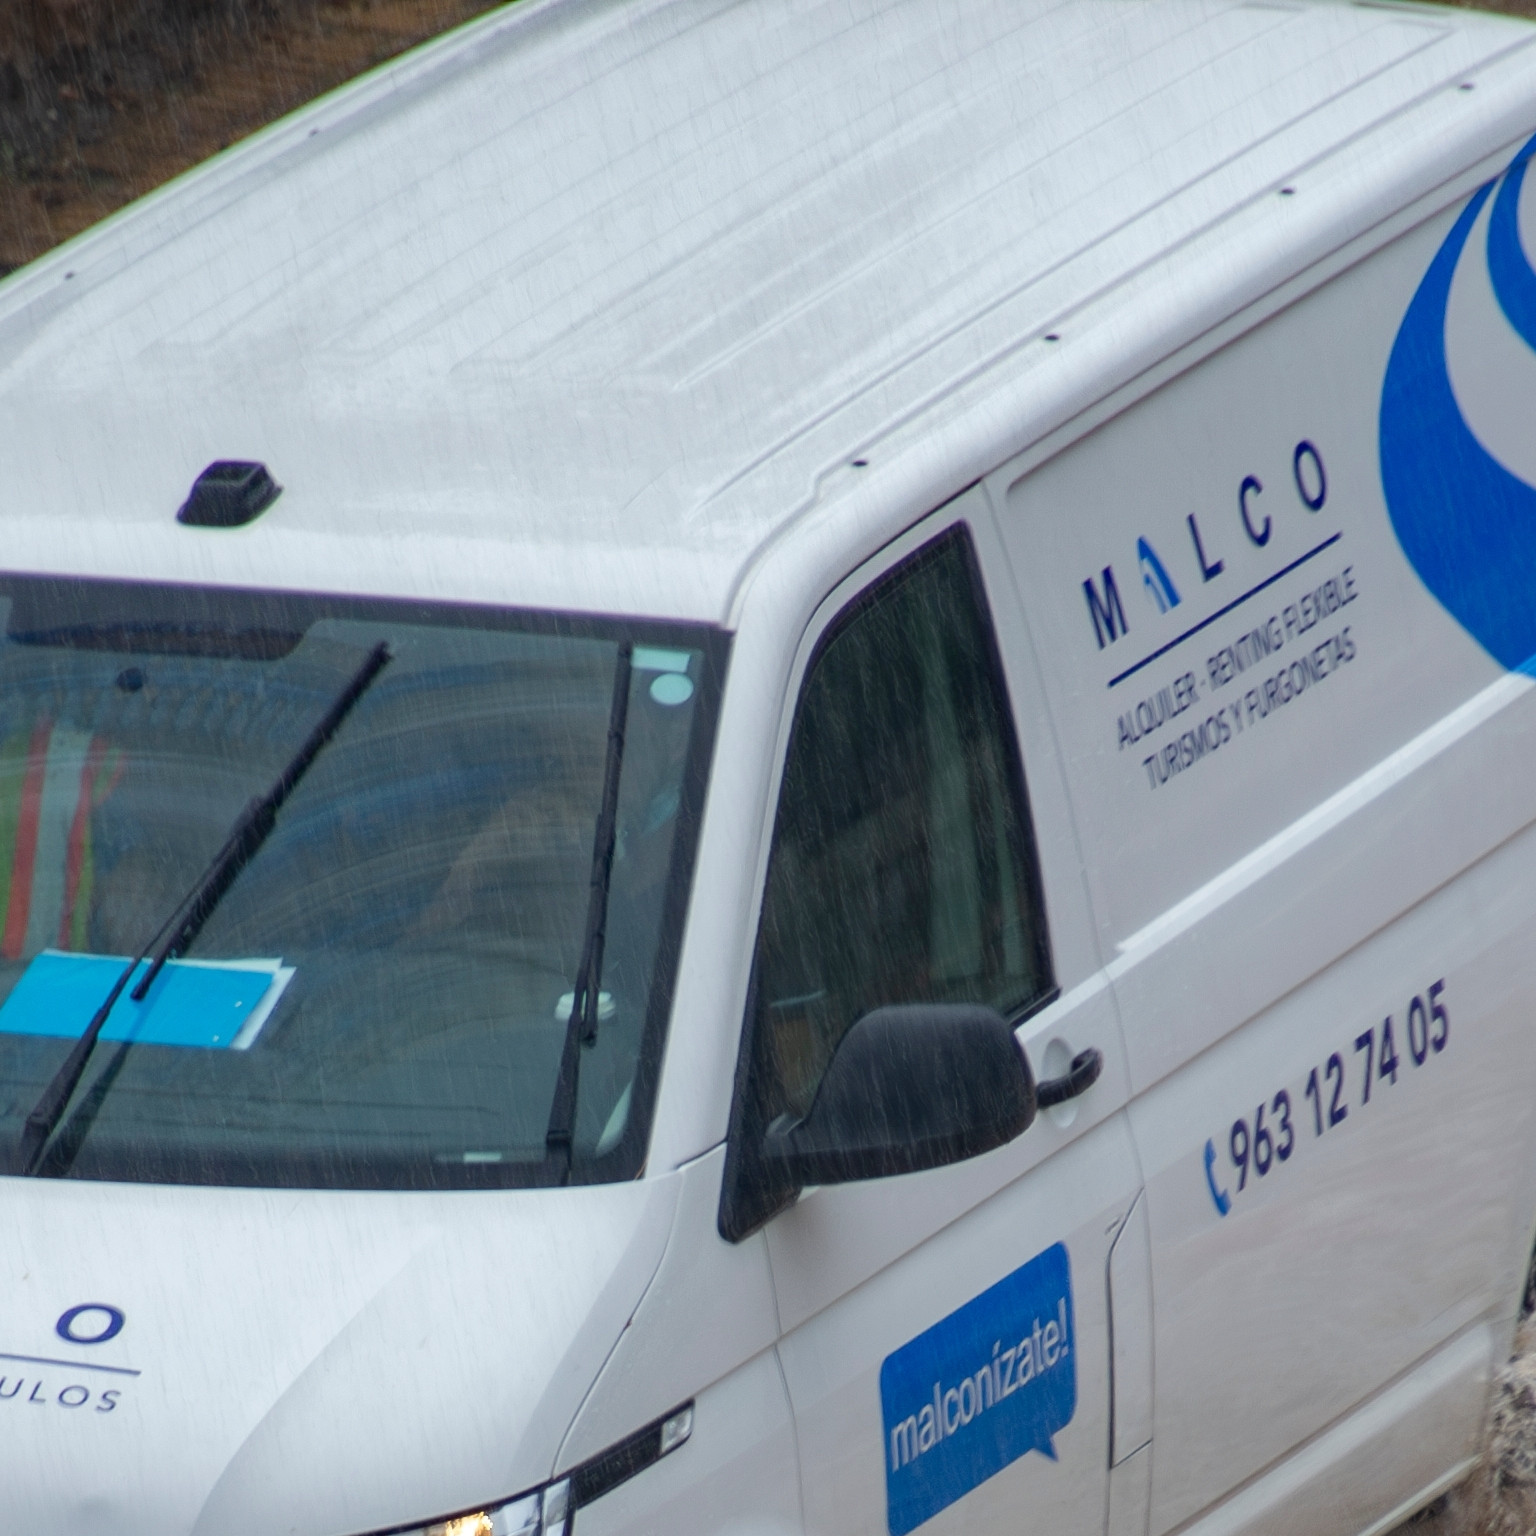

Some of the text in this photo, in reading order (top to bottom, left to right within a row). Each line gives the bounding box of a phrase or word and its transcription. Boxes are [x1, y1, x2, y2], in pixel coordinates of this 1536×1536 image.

[1082, 439, 1328, 650] MALCO
[1117, 671, 1200, 750] ALQUILER
[1206, 615, 1284, 691] RENTING
[1282, 564, 1360, 643] FLEXIBLE
[1142, 626, 1357, 790] TURISMOS Y FURGONETAS
[1229, 977, 1450, 1193] 963 12 74 05
[890, 1296, 1069, 1474] malconízate!
